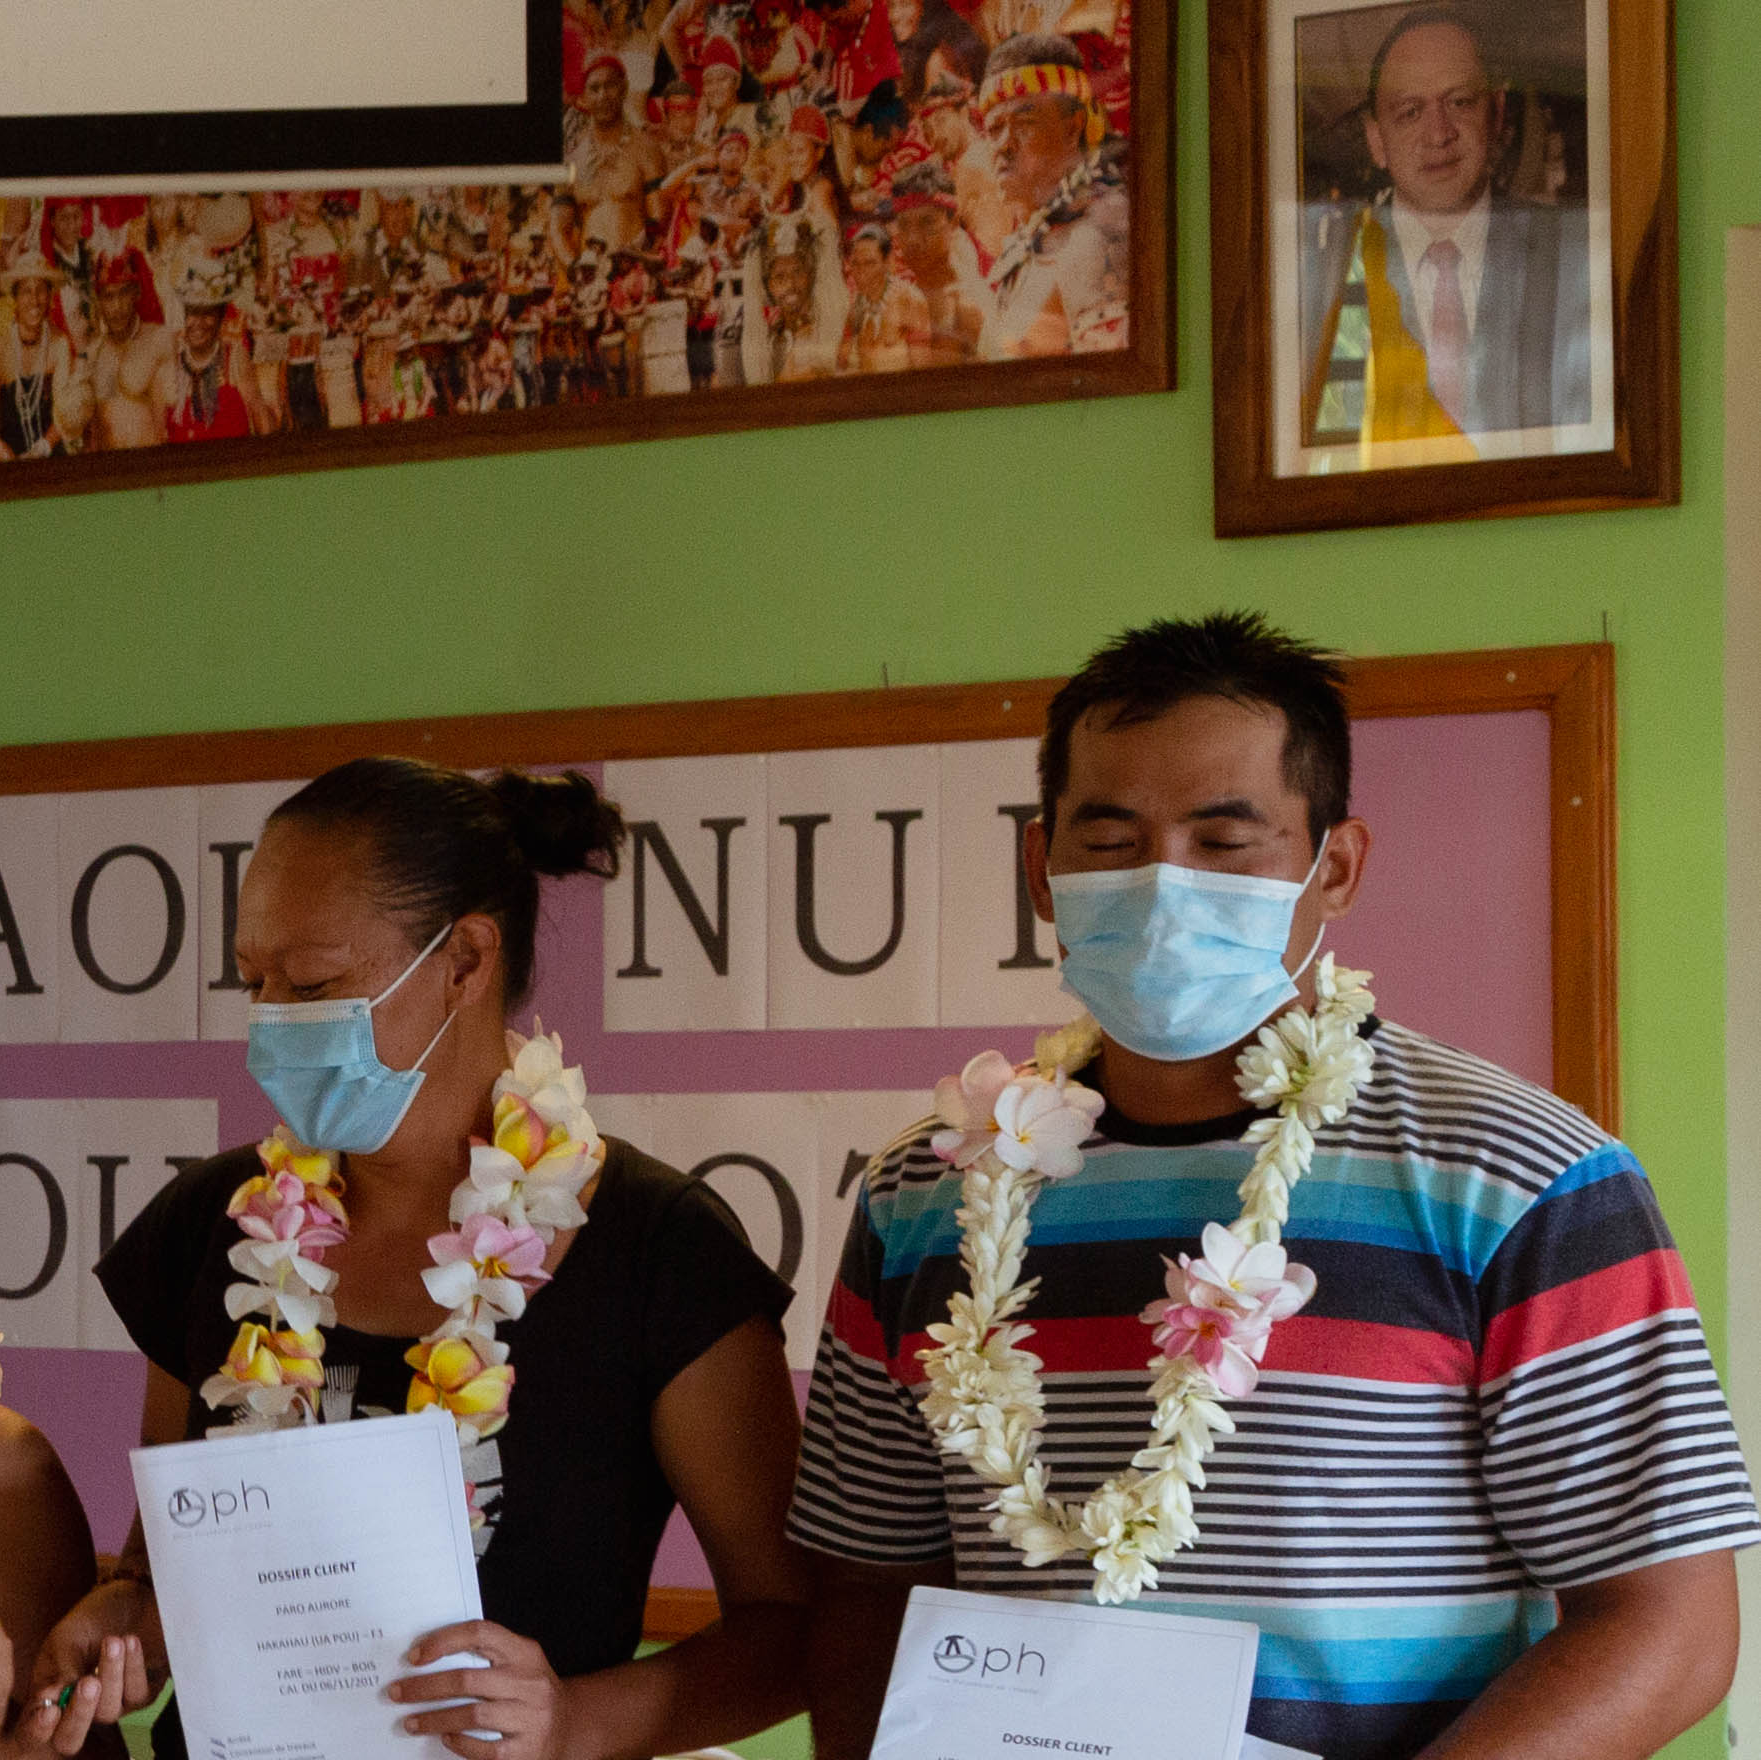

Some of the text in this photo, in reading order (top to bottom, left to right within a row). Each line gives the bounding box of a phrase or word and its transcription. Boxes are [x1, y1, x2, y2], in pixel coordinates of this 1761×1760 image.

[257, 1560, 358, 1584] DOSSIER CLIENT
[276, 1599, 352, 1616] PARO AURORE
[1002, 1732, 1113, 1756] DOSSIER CLIENT
